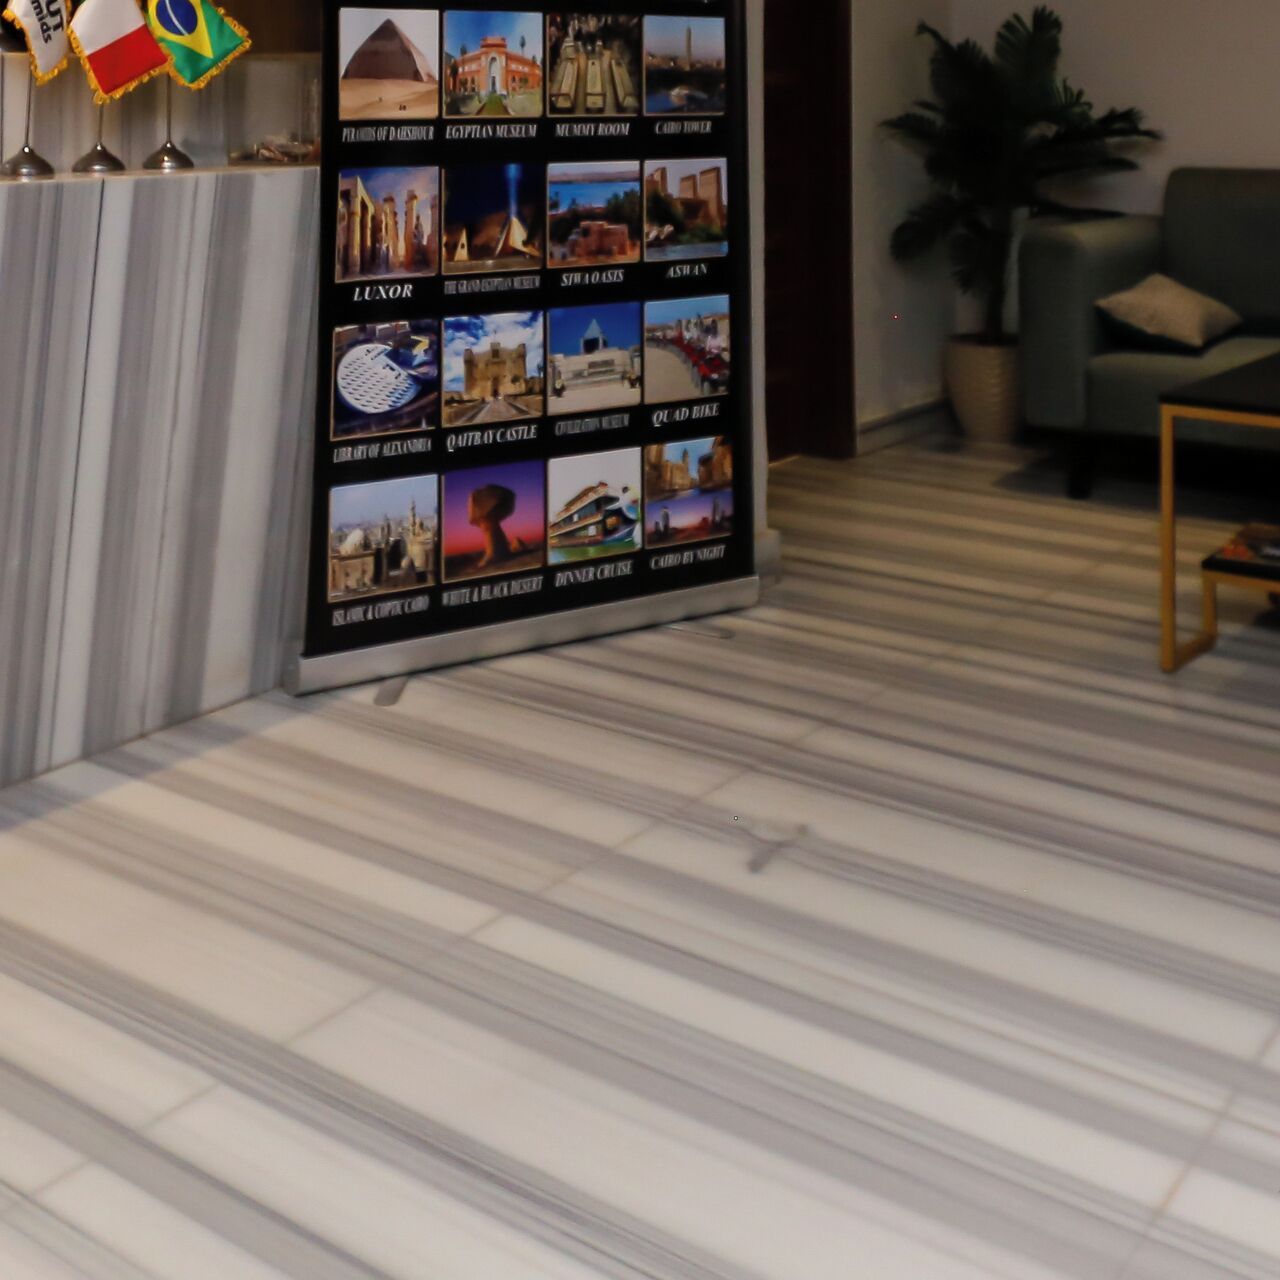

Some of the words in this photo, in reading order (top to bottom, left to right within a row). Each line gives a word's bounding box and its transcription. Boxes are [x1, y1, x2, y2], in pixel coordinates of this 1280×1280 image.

[377, 126, 388, 141] OF
[446, 124, 493, 140] EGYPTIAN
[496, 124, 537, 139] MUSEUM
[556, 123, 596, 137] MUMMY
[598, 122, 630, 136] ROOM
[655, 121, 682, 134] CAIRO
[683, 120, 712, 134] TOWER
[561, 272, 589, 287] SIWA
[591, 269, 625, 284] OASIS
[666, 263, 708, 279] ASWAN
[352, 284, 414, 302] LUXOR
[652, 408, 690, 427] QUAD
[692, 402, 720, 419] BIKE
[446, 429, 493, 452] QAITBAY
[496, 424, 538, 443] CASTLE
[651, 553, 682, 570] CAIRO
[682, 551, 694, 566] BY
[696, 544, 727, 561] NIGHT
[555, 567, 595, 588] DINNER
[597, 559, 634, 580] CRUISE
